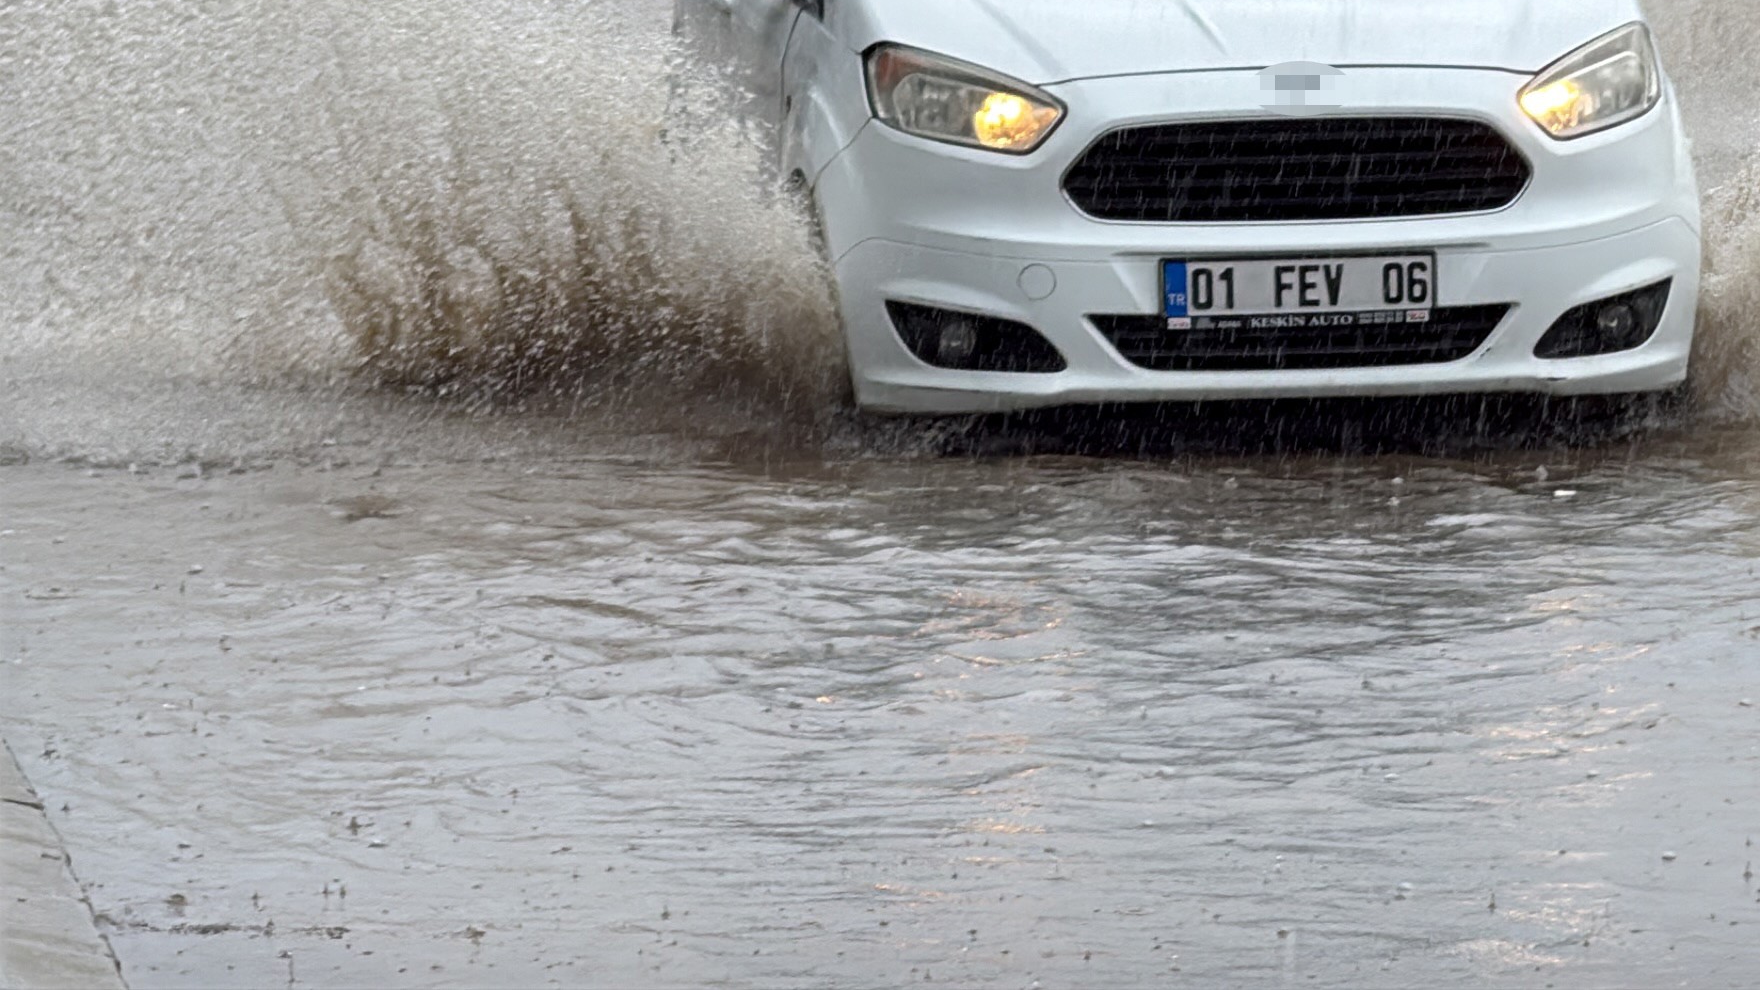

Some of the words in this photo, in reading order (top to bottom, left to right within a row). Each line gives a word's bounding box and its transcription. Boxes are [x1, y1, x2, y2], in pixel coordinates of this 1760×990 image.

[1167, 293, 1186, 306] TR
[1190, 267, 1235, 310] 01
[1273, 263, 1345, 308] FEV
[1382, 261, 1428, 305] 06
[1308, 314, 1354, 326] AUTO
